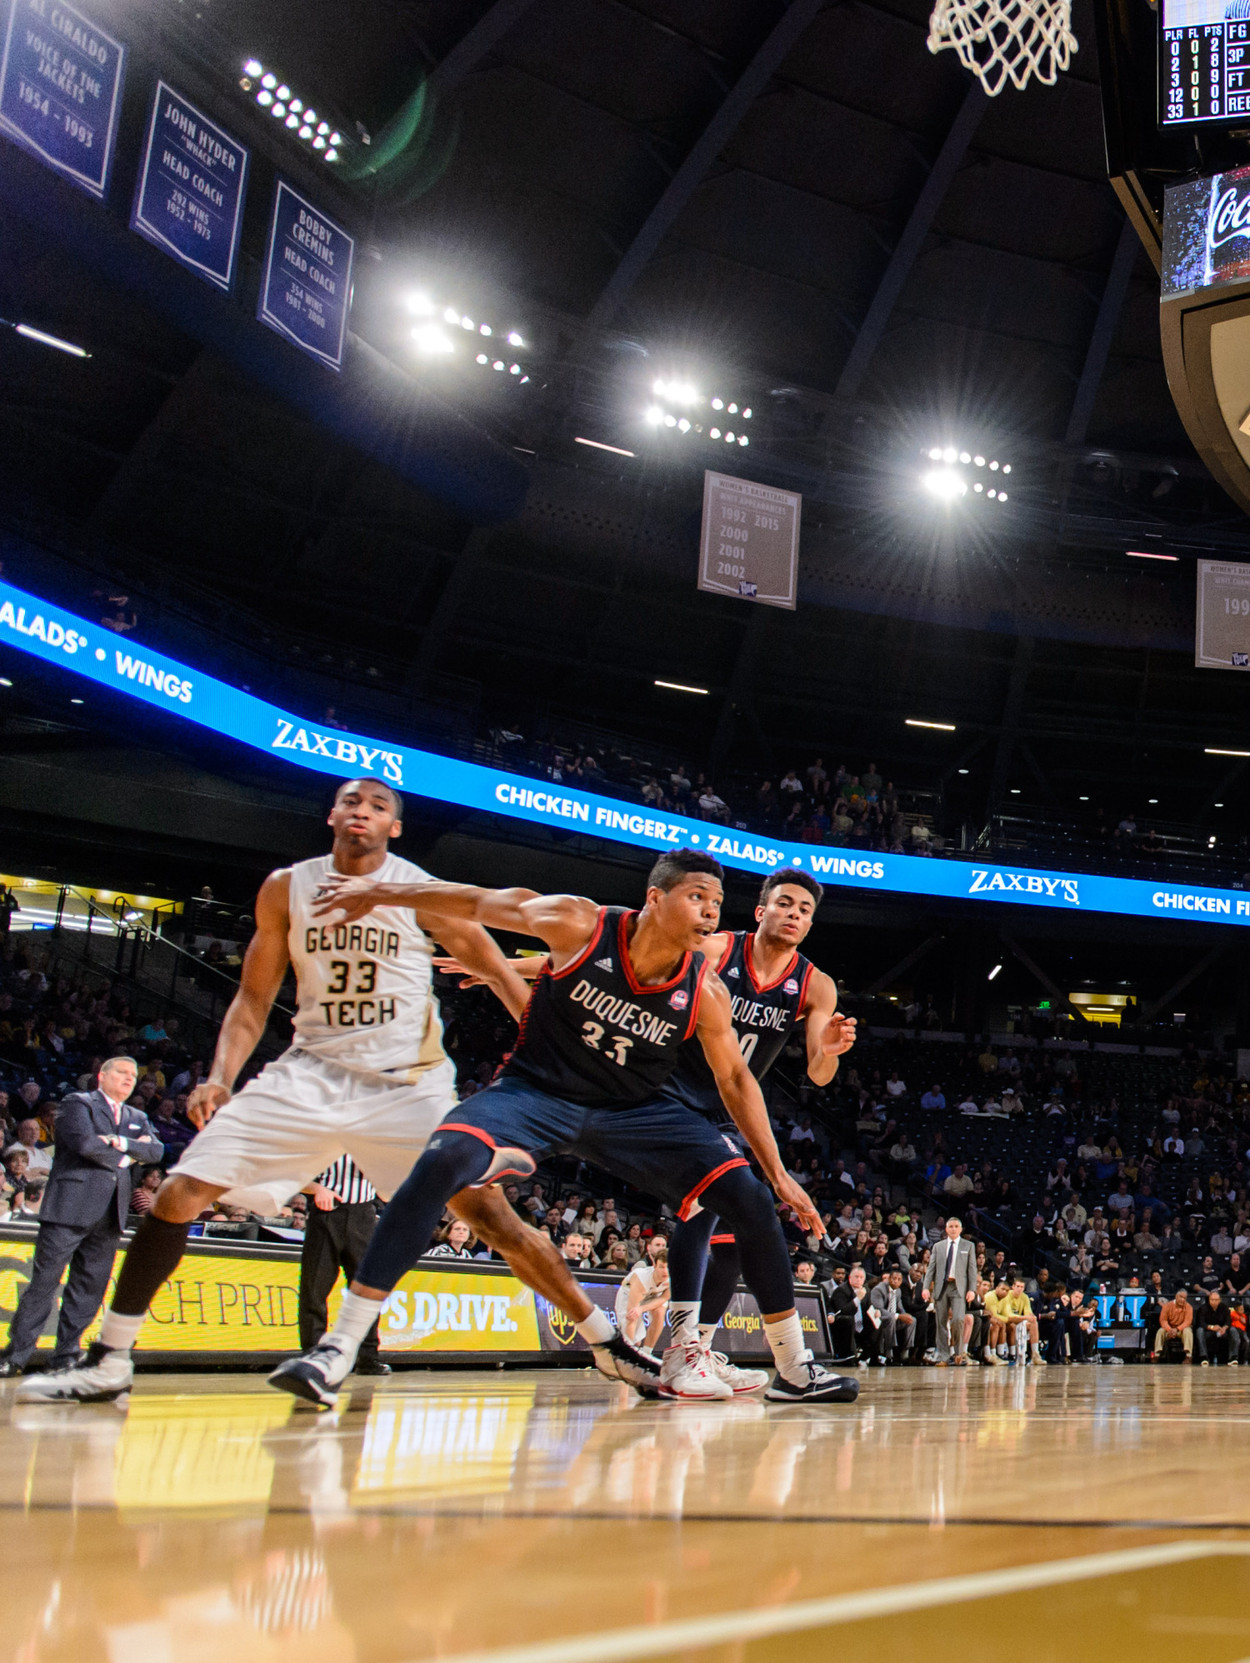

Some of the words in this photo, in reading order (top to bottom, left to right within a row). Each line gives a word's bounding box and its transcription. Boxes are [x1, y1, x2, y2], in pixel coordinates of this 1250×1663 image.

[51, 10, 107, 64] CIRALDO
[1165, 29, 1183, 41] PLR
[1188, 28, 1199, 39] FL
[1204, 25, 1223, 37] PTS
[1171, 41, 1180, 56] 0
[1191, 39, 1199, 54] 0
[1210, 37, 1219, 52] 2
[1229, 23, 1247, 39] FG
[27, 30, 60, 67] VOICE
[62, 58, 77, 79] OF
[80, 71, 101, 98] THE
[1171, 57, 1179, 72] 2
[1210, 53, 1219, 68] 8
[1228, 48, 1244, 63] 3P
[38, 59, 85, 104] JACKETS
[1169, 88, 1183, 103] 12
[1191, 86, 1199, 101] 0
[1210, 84, 1219, 99] 0
[1171, 72, 1179, 87] 3
[1191, 71, 1199, 85] 0
[1210, 68, 1219, 83] 9
[1228, 72, 1244, 87] FT
[19, 81, 49, 116] 1954
[64, 115, 93, 148] 1993
[1167, 104, 1183, 119] 33
[1211, 100, 1219, 114] 0
[164, 103, 197, 139] JOHN
[199, 129, 236, 172] HYDER
[162, 150, 190, 181] HEAD
[192, 174, 223, 207] COACH
[166, 200, 185, 221] 1952
[171, 189, 187, 208] 292
[188, 200, 209, 226] WINS
[299, 209, 332, 246] BOBBY
[292, 223, 335, 266] CREMINS
[284, 246, 307, 272] HEAD
[309, 265, 336, 295] COACH
[721, 506, 747, 523] 1992
[754, 514, 779, 531] 2015
[720, 525, 748, 542] 2000
[719, 543, 745, 560] 2001
[717, 561, 745, 579] 2002
[115, 650, 194, 703] WINGS
[271, 718, 404, 786] ZAXBY'S
[495, 783, 590, 822] CHICKEN
[810, 854, 885, 880] WINGS
[968, 869, 1080, 905] ZAXBY'S
[1152, 891, 1232, 914] CHICKEN
[306, 925, 399, 958] GEORGIA
[327, 960, 377, 994] 33
[320, 999, 396, 1026] TECH
[569, 979, 678, 1047] DUQUESNE
[215, 1282, 300, 1326] PRID
[413, 1292, 518, 1332] DRIVE.
[724, 1312, 761, 1334] Georgia
